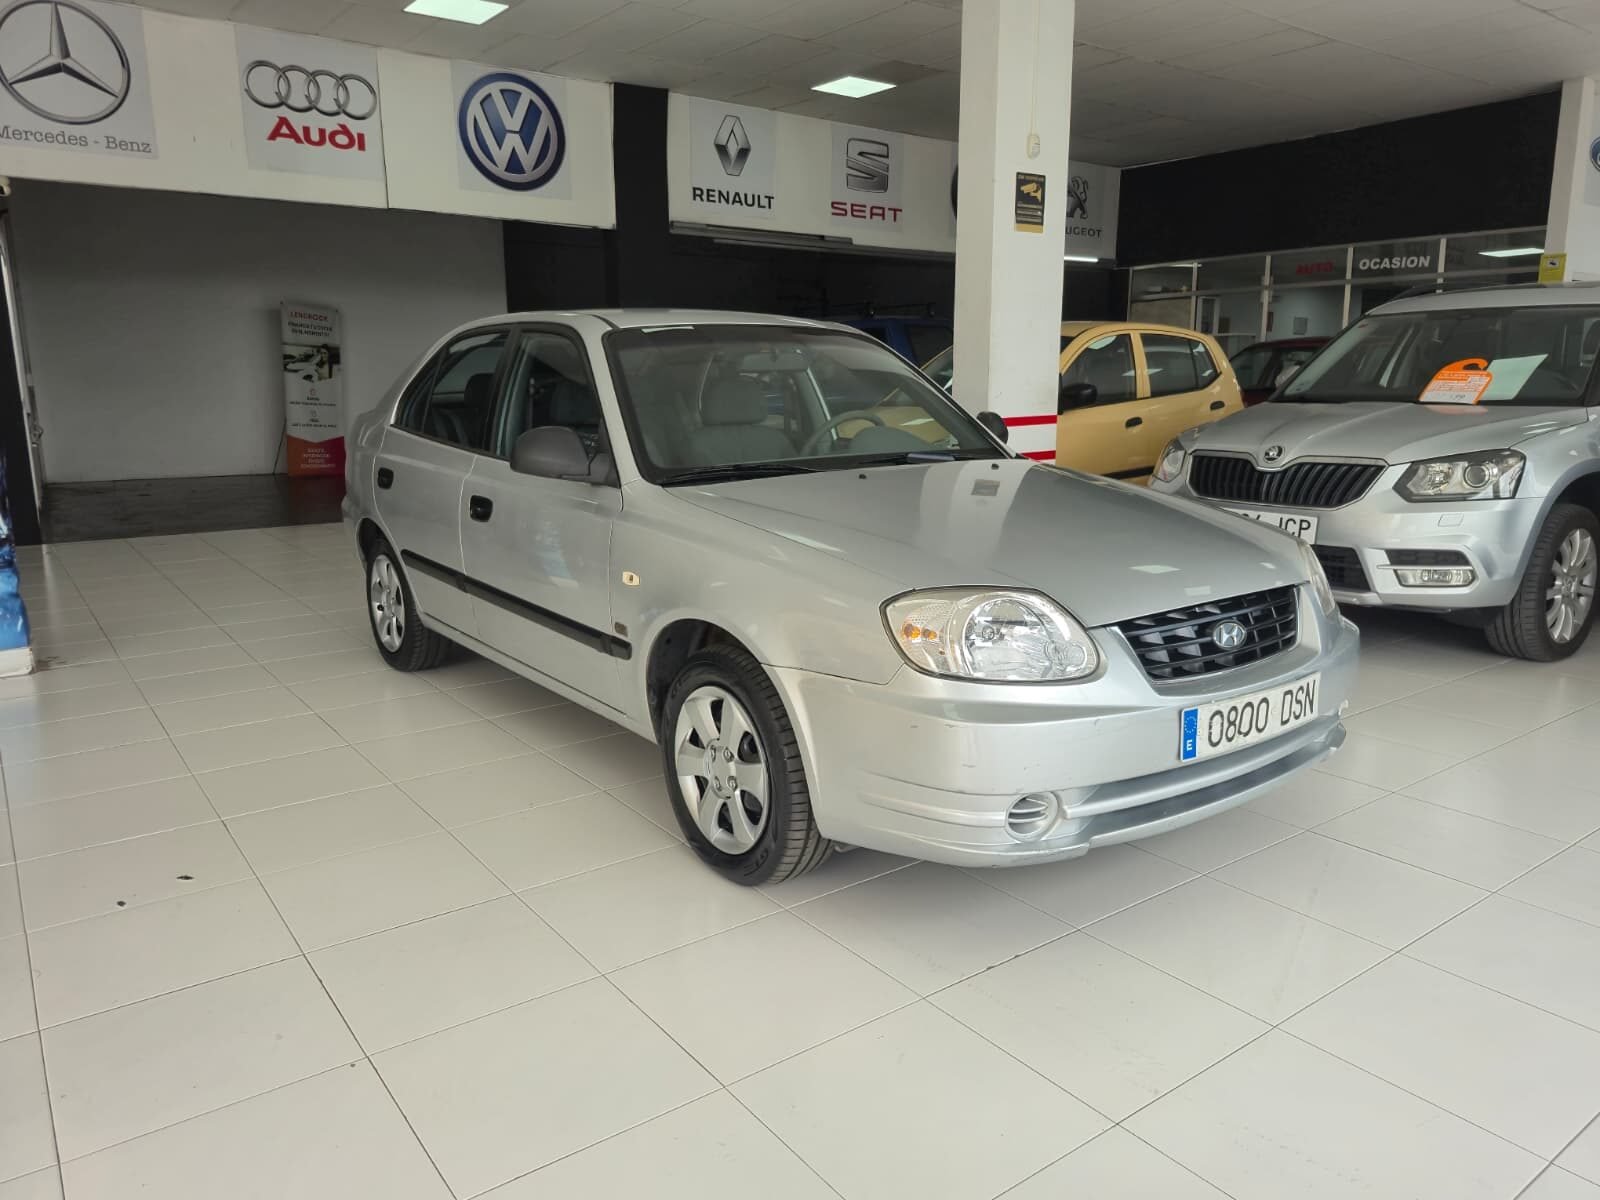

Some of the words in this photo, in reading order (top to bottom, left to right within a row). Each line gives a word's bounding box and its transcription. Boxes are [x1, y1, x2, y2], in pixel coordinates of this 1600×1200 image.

[0, 125, 89, 147] Mercedes
[104, 135, 152, 154] Benz
[266, 116, 366, 152] Audi
[692, 186, 775, 210] RENAULT
[831, 201, 903, 223] SEAT
[1065, 226, 1102, 238] UGEOT
[1358, 255, 1431, 271] OCASION
[1186, 739, 1193, 751] E
[1207, 697, 1270, 748] 0800
[1281, 680, 1316, 727] DSN
